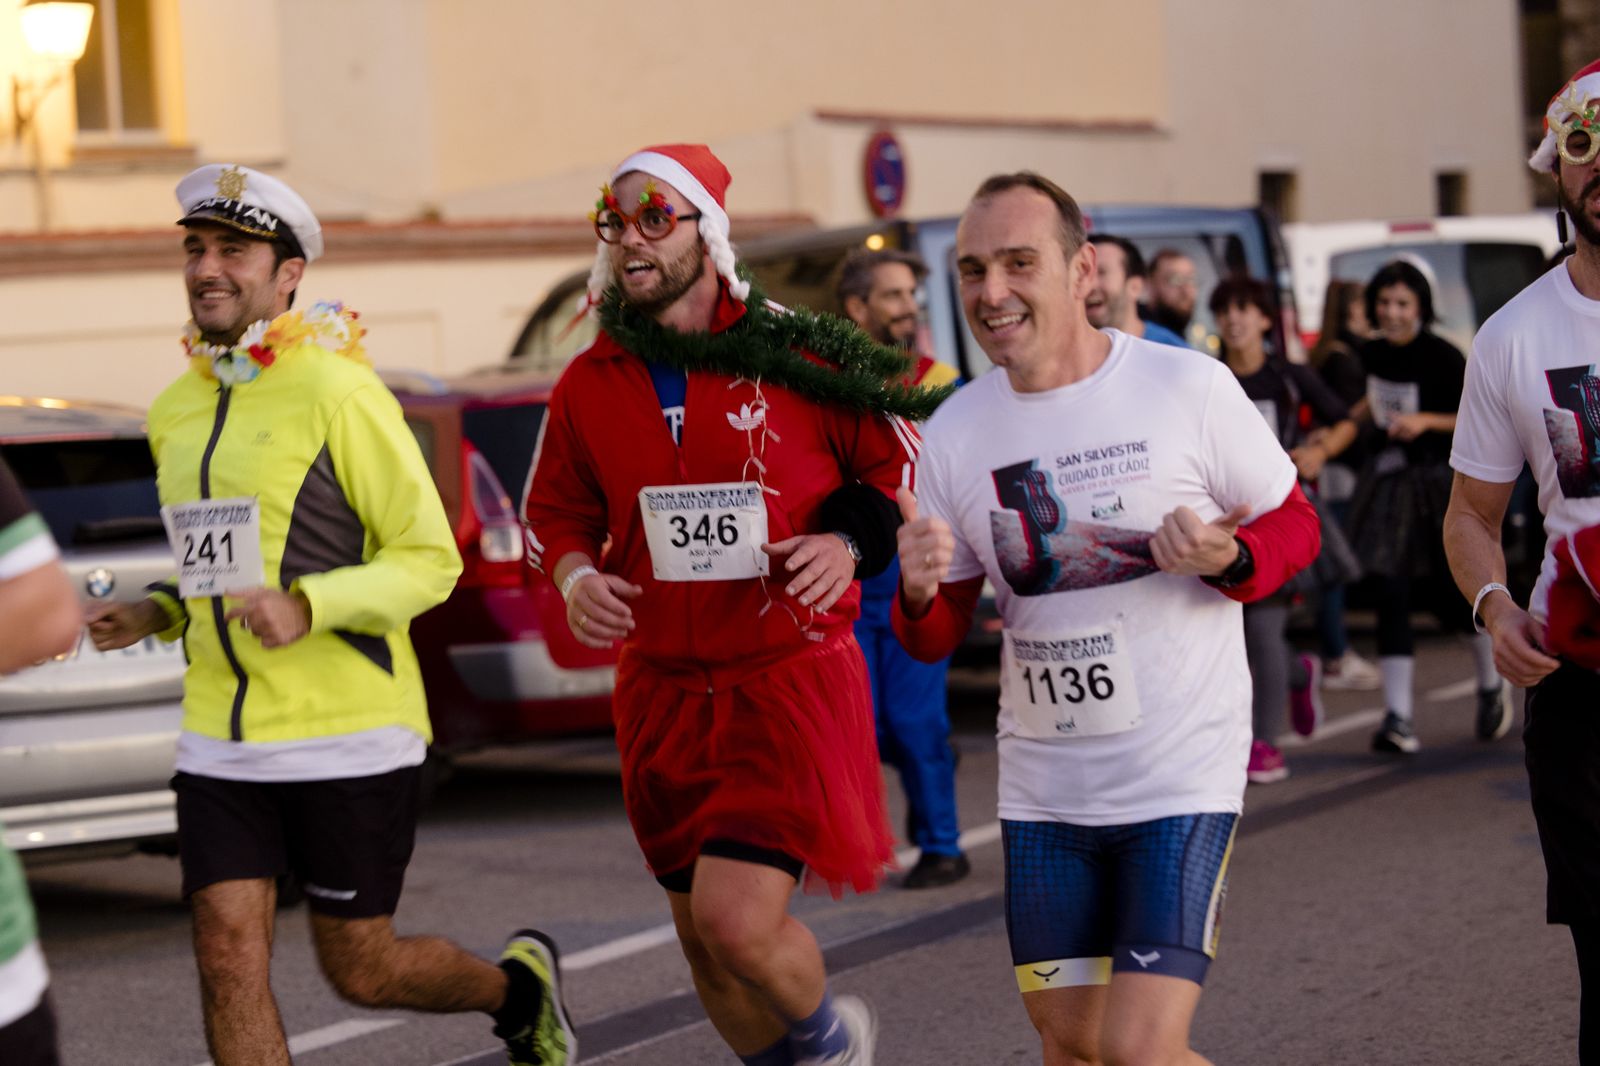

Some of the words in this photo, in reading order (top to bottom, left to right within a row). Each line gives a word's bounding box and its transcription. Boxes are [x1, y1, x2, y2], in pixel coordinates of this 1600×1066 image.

[1056, 453, 1081, 469] SAN
[1084, 440, 1147, 462] SILVESTRE
[1058, 466, 1099, 486] CIUDAD
[1101, 463, 1116, 477] DE
[1119, 457, 1150, 474] CÁDIZ
[644, 491, 675, 500] SAN
[699, 498, 715, 509] DE
[669, 514, 738, 548] 346
[183, 530, 233, 567] 241
[1032, 632, 1113, 650] SILVESTRE
[1023, 663, 1114, 705] 1136
